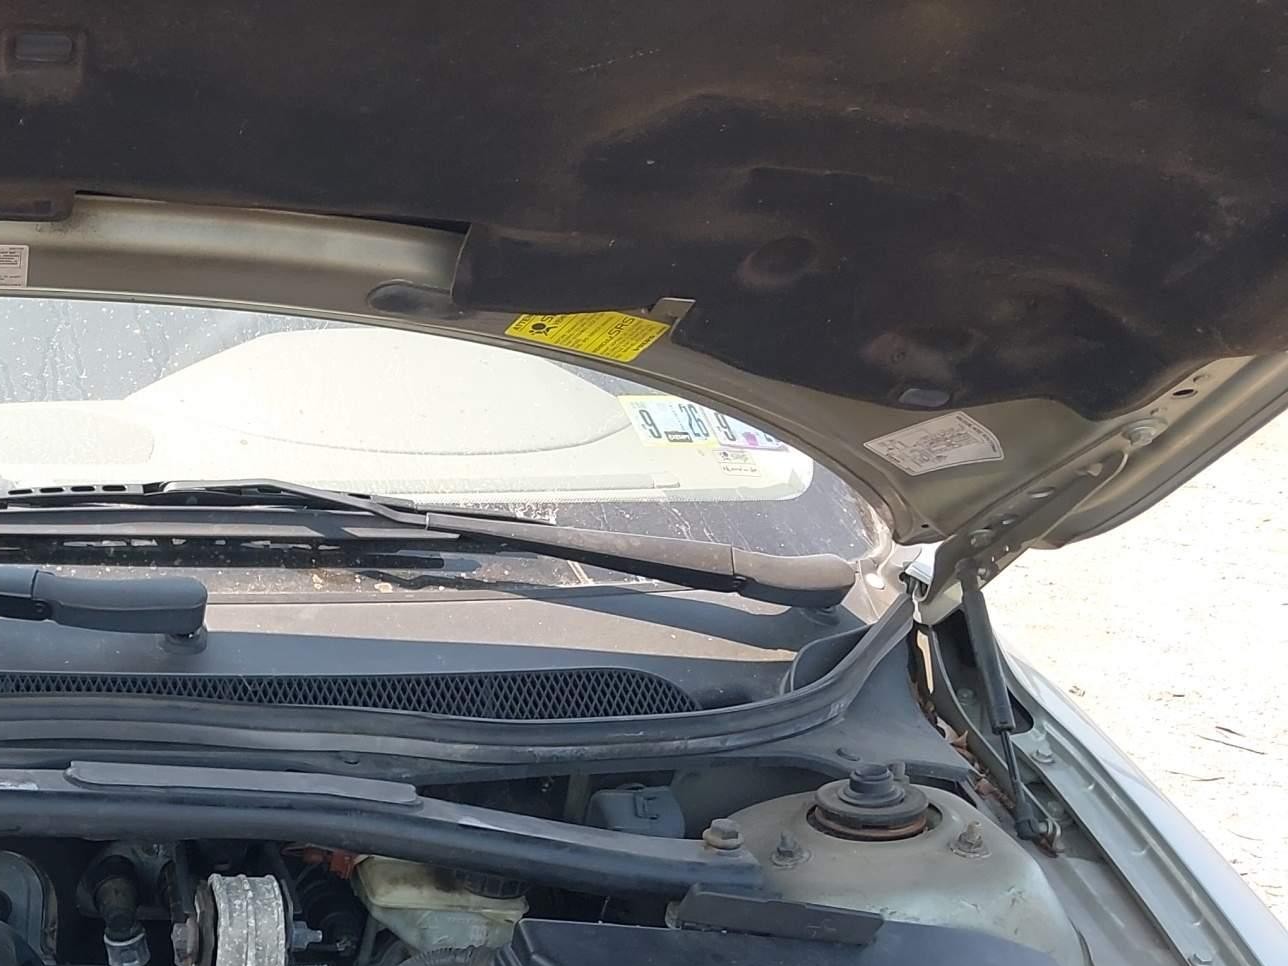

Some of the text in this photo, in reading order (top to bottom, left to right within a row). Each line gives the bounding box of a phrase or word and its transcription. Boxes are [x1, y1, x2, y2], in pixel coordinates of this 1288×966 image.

[608, 316, 635, 337] SRS
[638, 409, 662, 439] 9
[677, 403, 710, 438] 26
